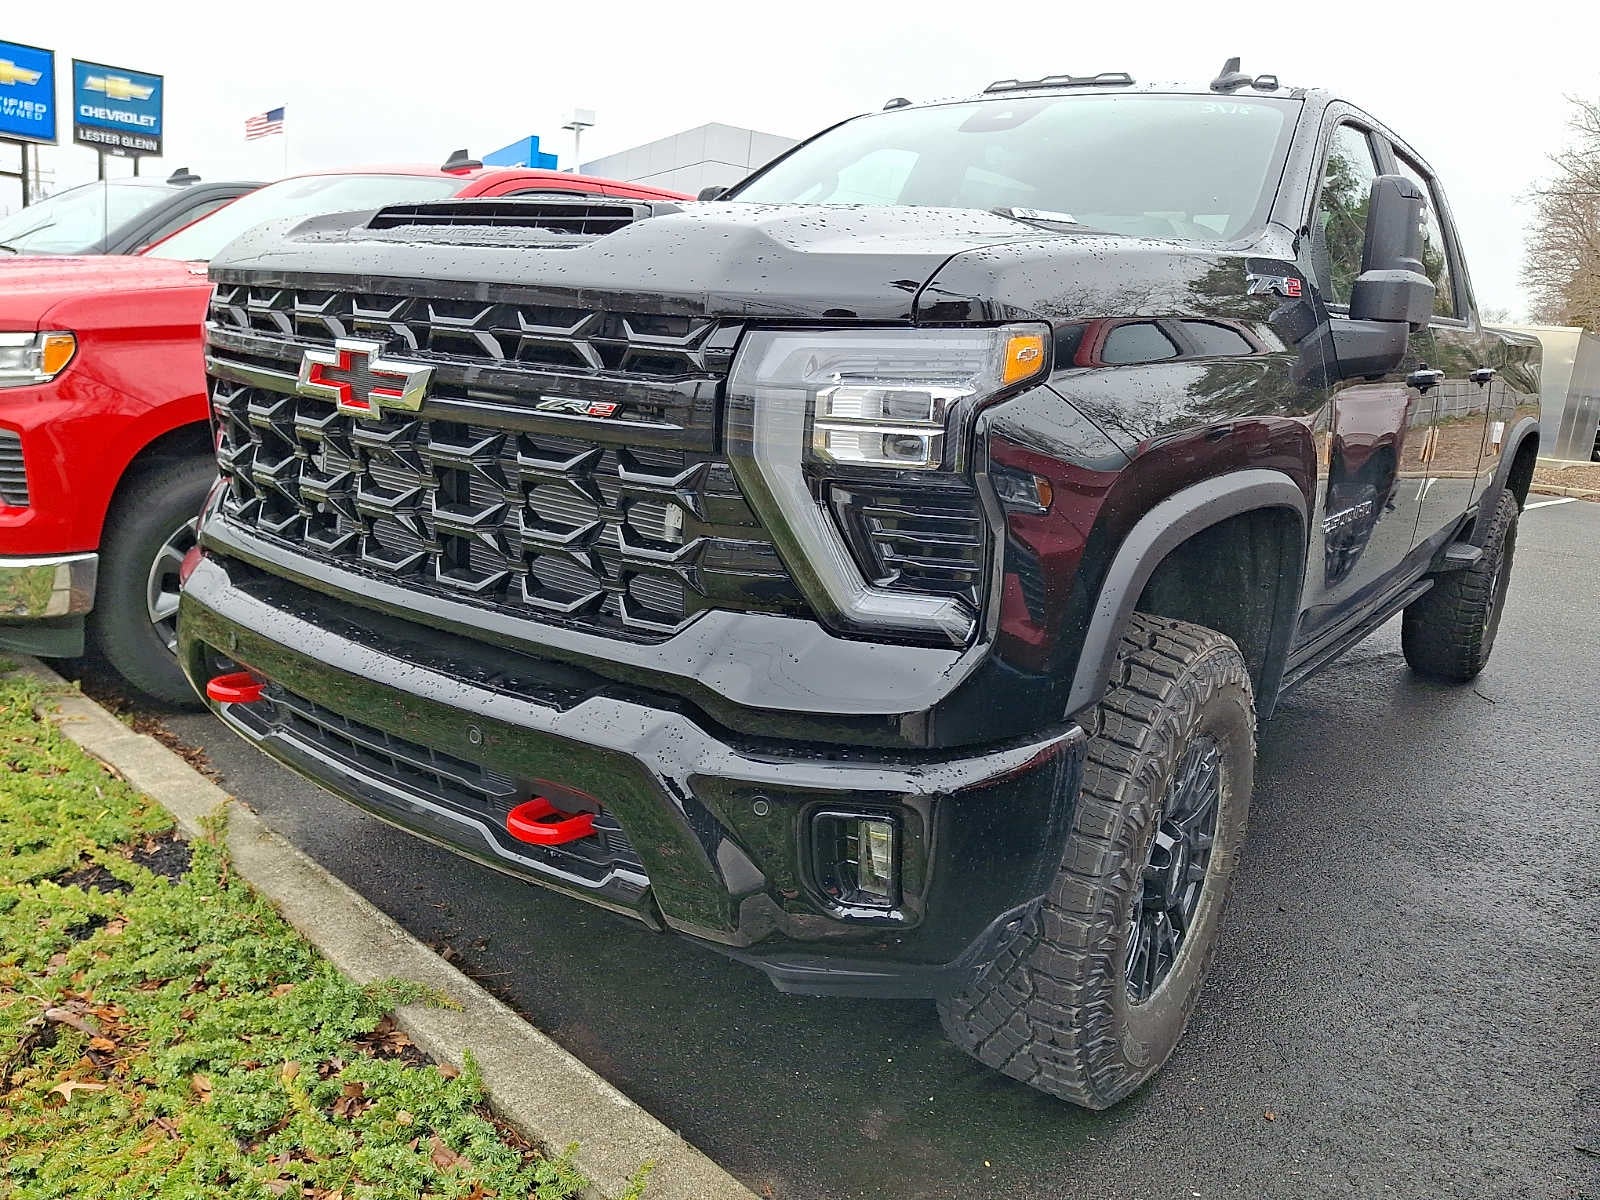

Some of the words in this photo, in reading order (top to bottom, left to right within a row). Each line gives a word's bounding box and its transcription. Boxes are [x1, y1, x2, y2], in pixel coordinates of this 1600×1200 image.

[0, 105, 43, 121] WNED
[80, 104, 157, 127] CHEVROLET
[79, 128, 120, 145] LESTER
[121, 136, 157, 151] GLENN
[1246, 273, 1302, 297] ZR2
[535, 396, 618, 417] ZR2
